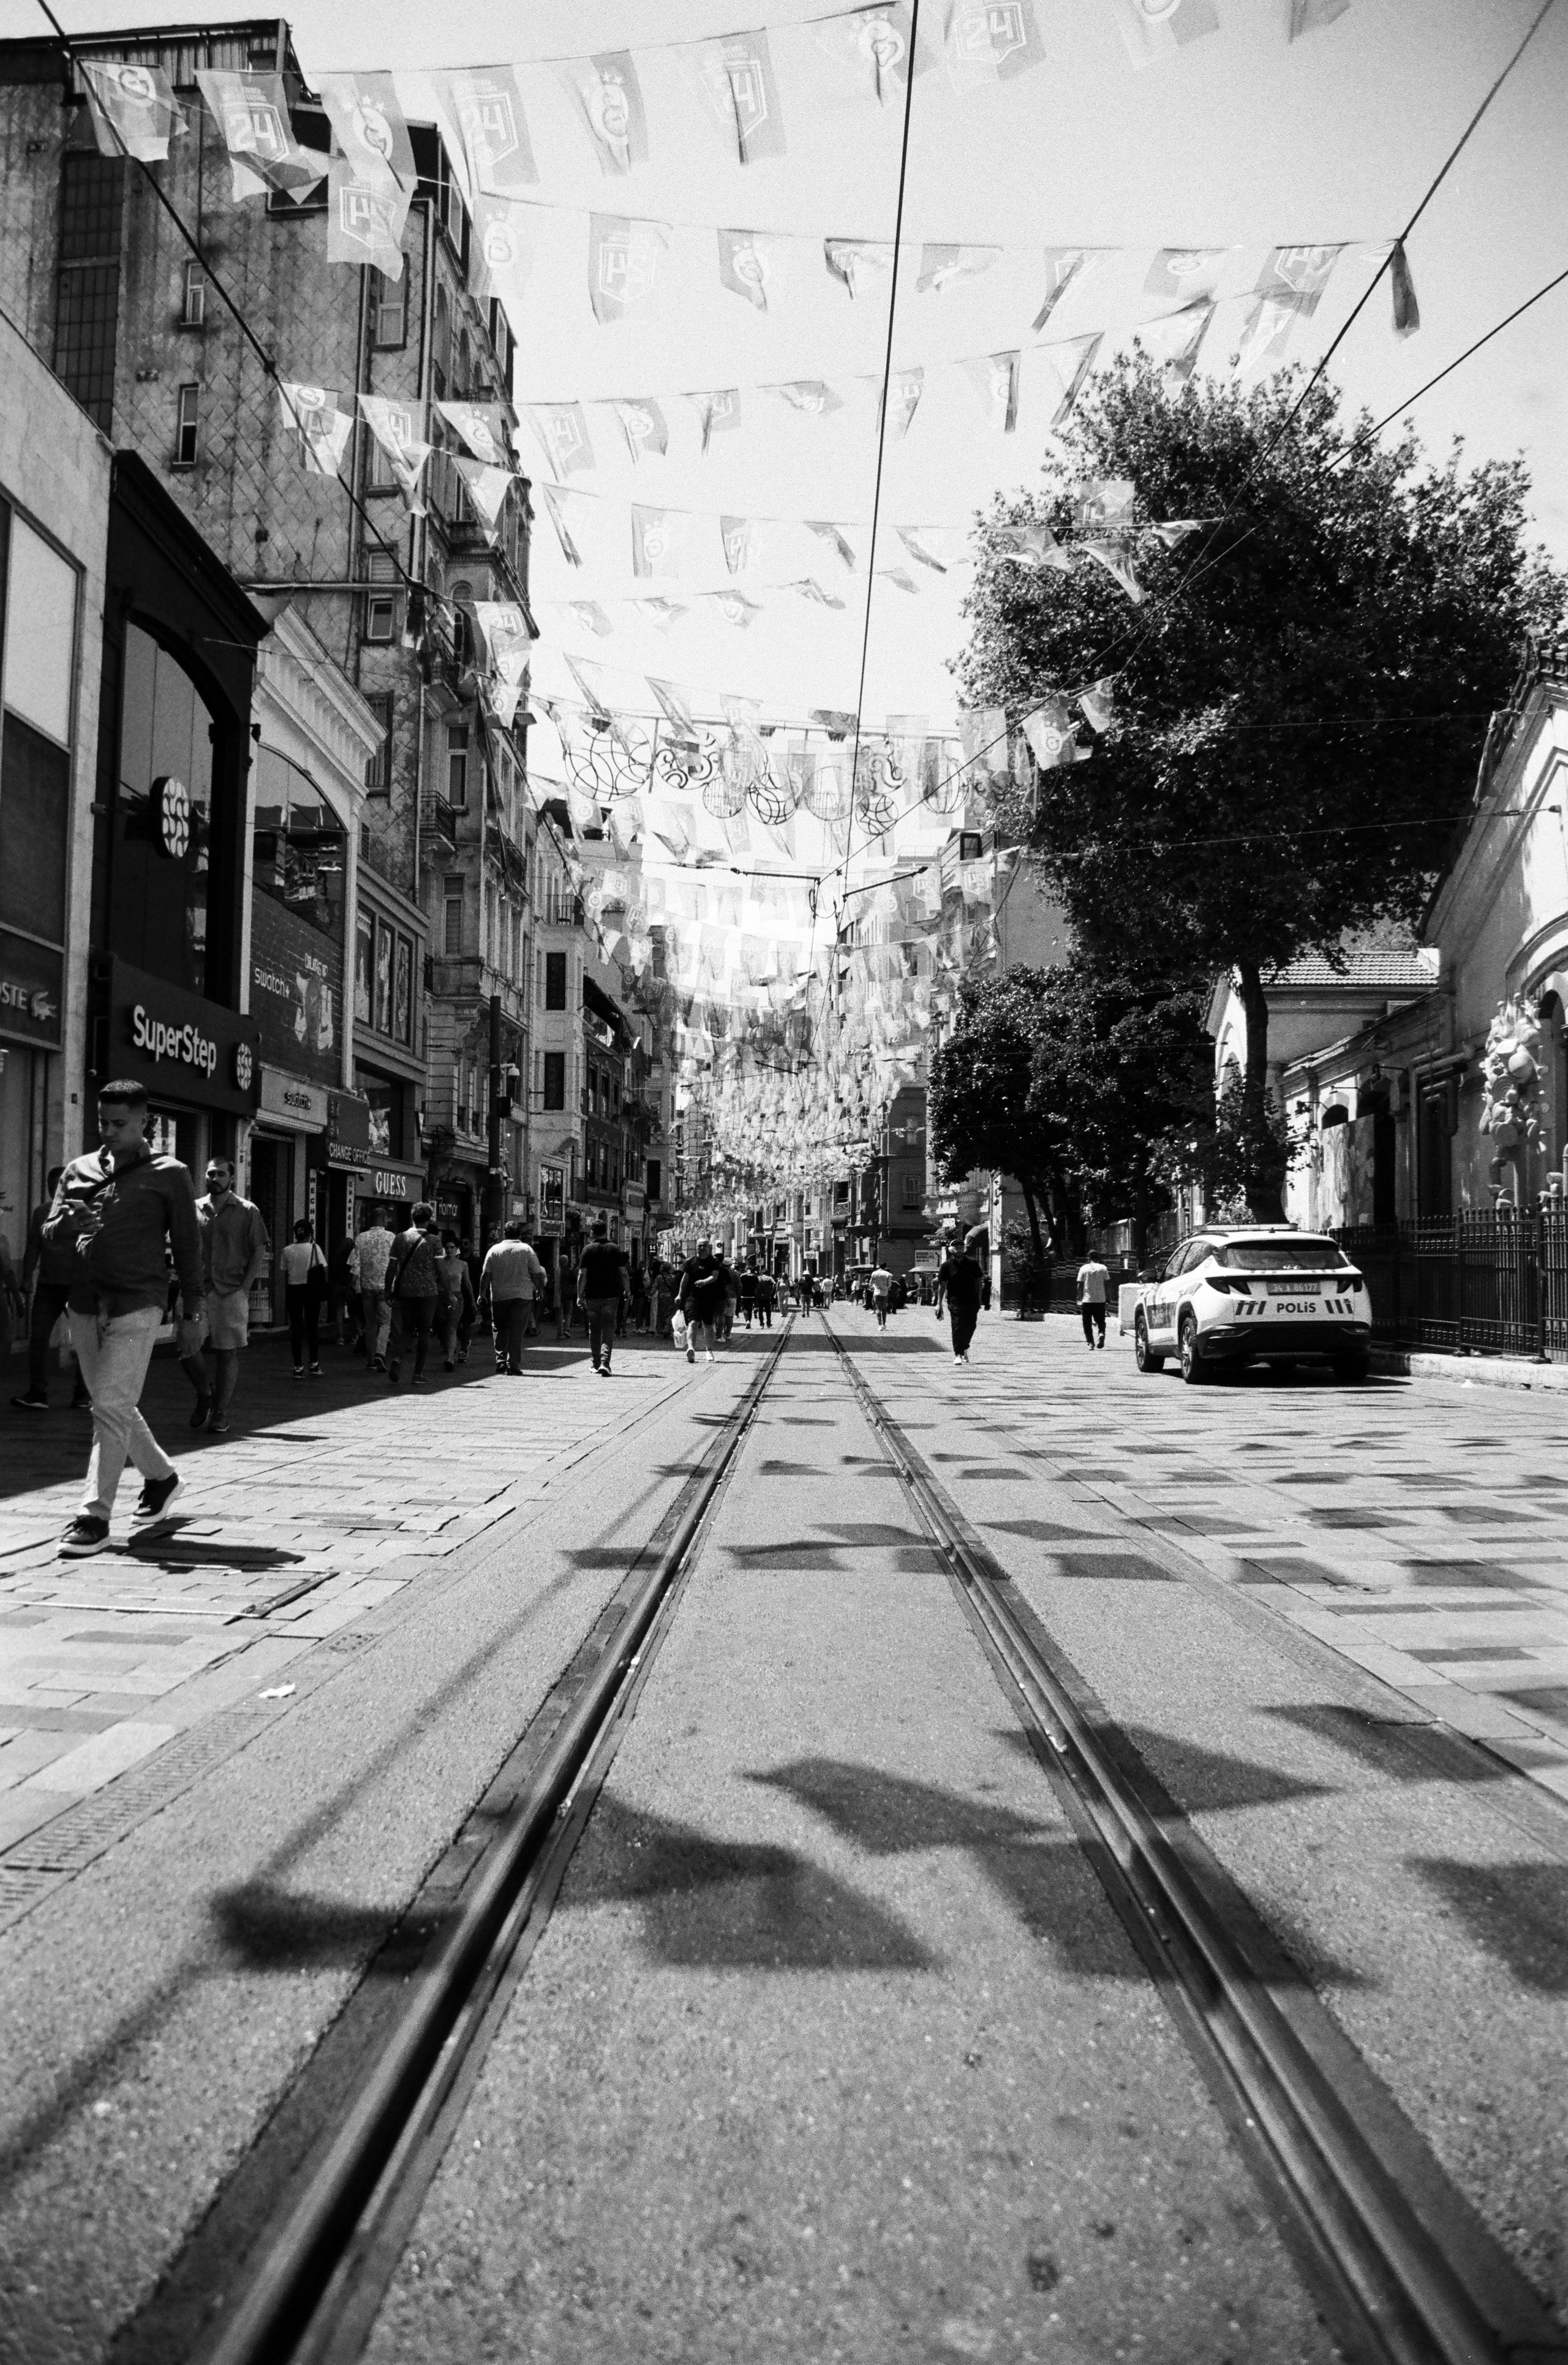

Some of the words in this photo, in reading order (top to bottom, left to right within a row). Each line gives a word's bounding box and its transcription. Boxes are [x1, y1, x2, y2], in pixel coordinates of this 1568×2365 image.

[228, 113, 277, 150] 24
[133, 1005, 217, 1079] SuperStep
[329, 1142, 352, 1161] CHANGE
[375, 1171, 406, 1196] GUESS
